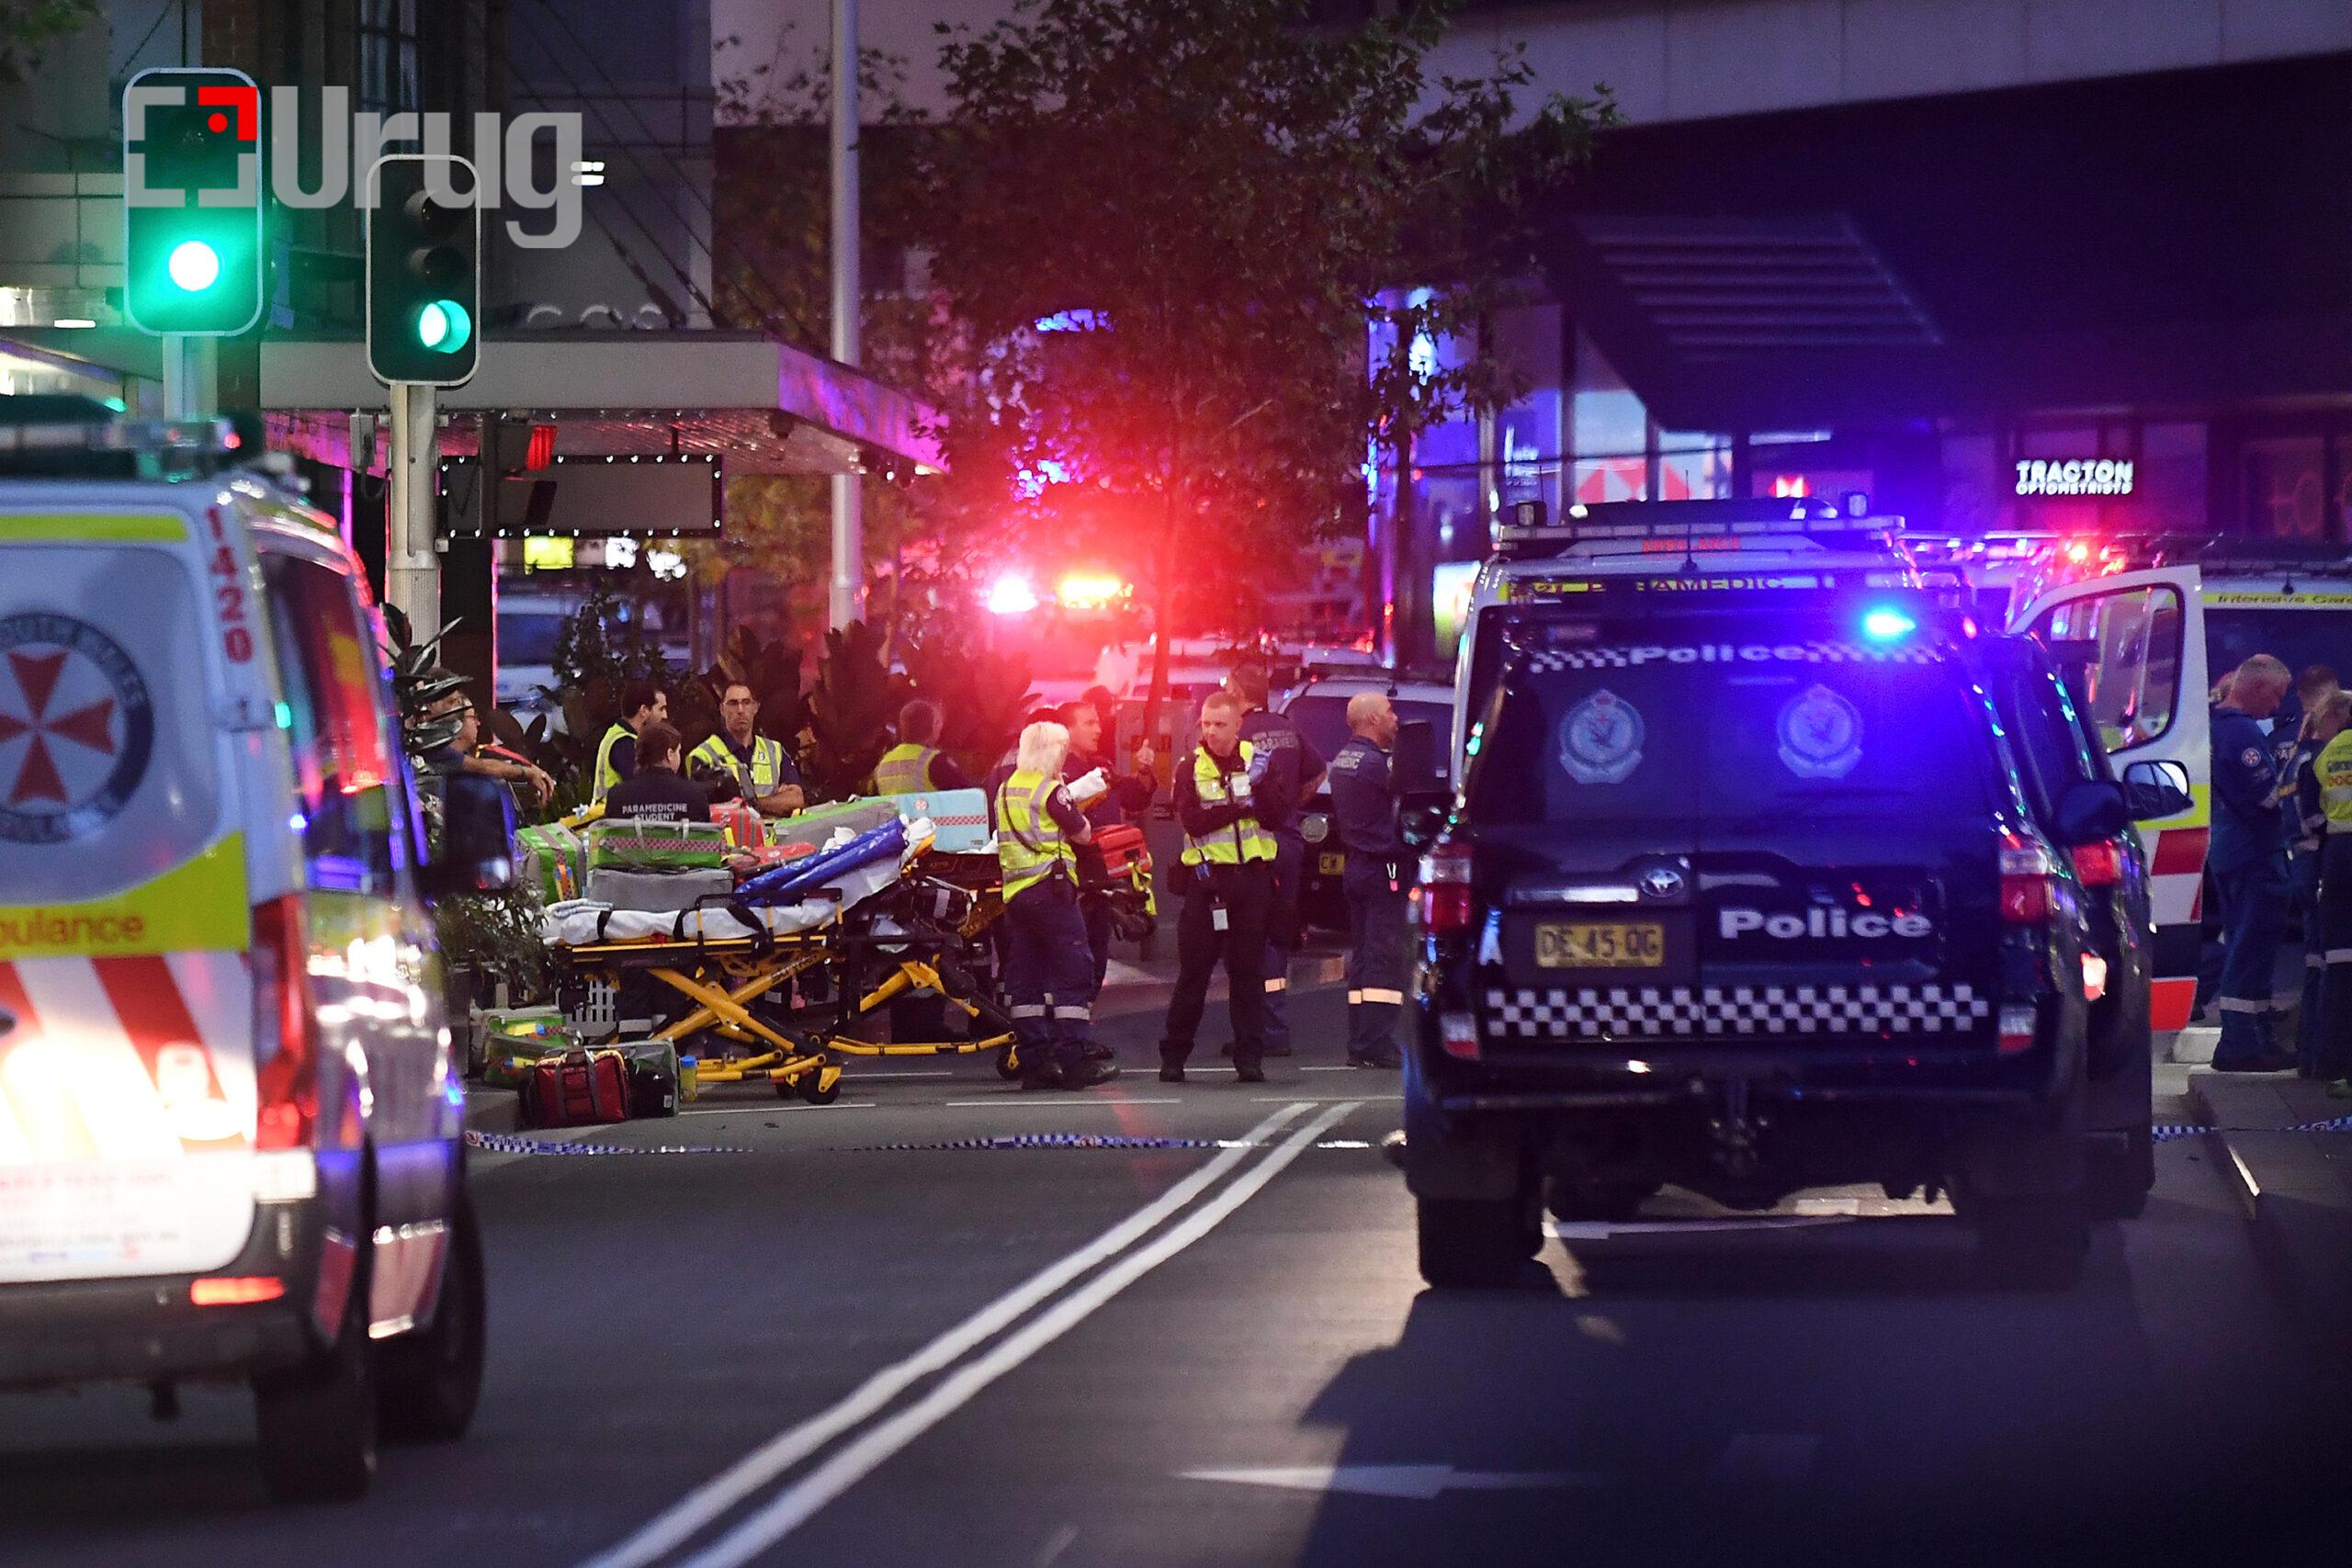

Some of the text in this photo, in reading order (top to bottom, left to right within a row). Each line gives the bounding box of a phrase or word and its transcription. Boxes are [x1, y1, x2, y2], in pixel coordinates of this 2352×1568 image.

[2016, 459, 2133, 483] TRACTON
[1630, 644, 1805, 664] Police
[622, 803, 688, 814] PARAMEDICINE
[1720, 908, 1932, 939] Police
